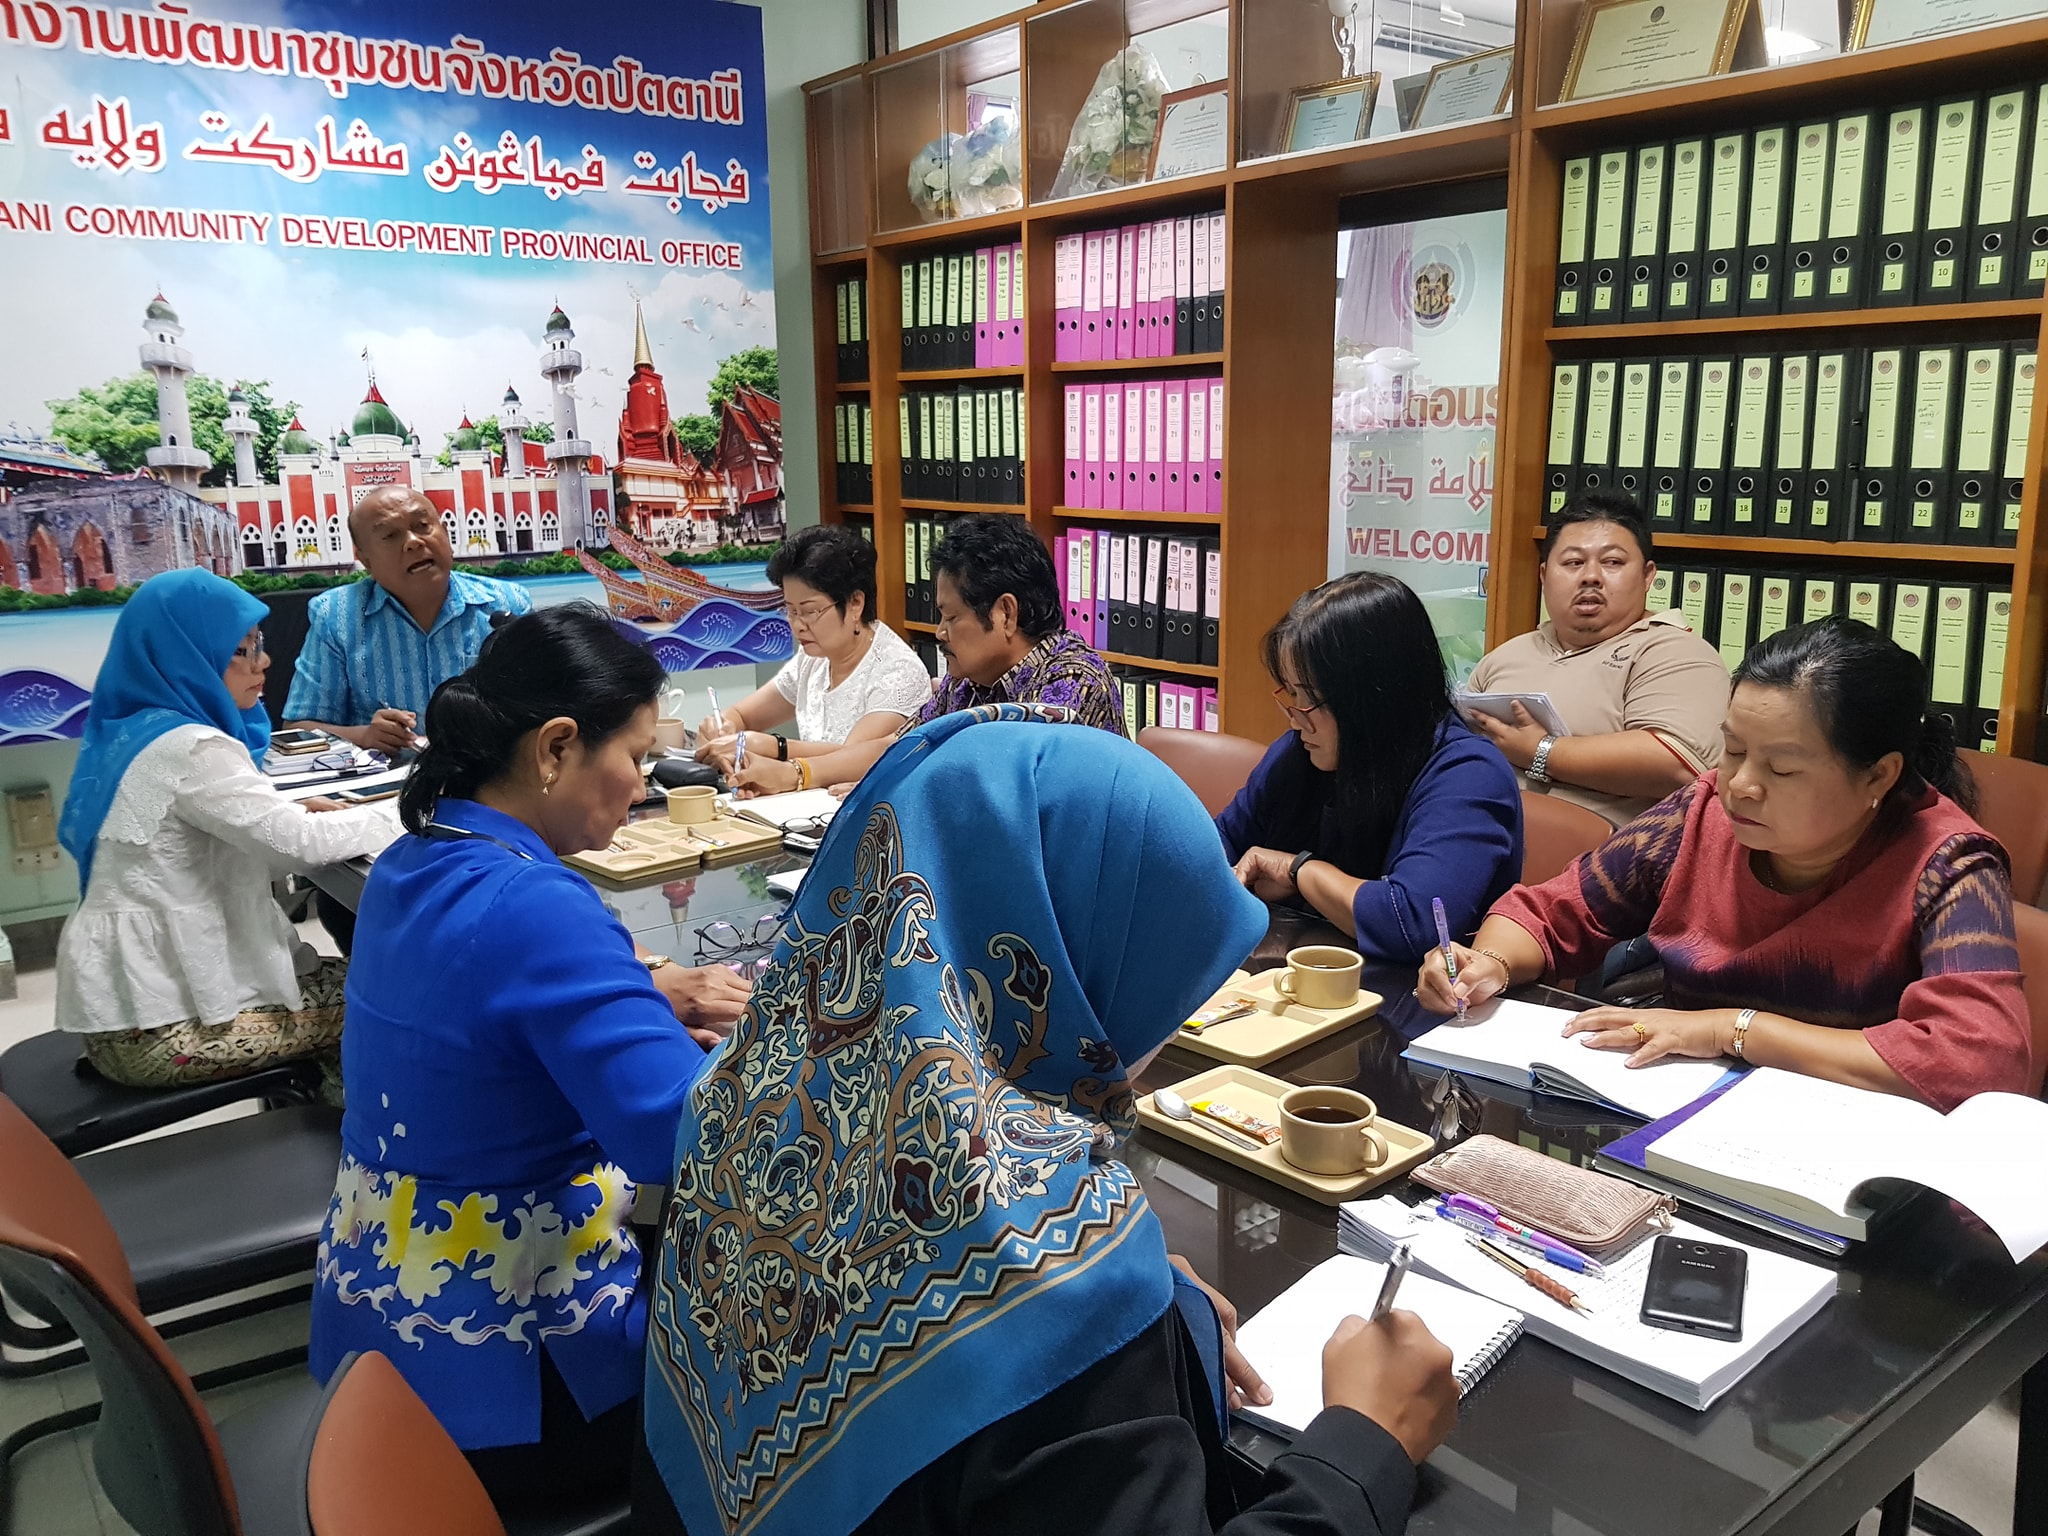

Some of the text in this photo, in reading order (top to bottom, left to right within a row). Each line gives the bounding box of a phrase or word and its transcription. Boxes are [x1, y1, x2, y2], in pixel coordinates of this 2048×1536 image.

[65, 206, 268, 242] COMMUNITY
[282, 217, 492, 252] DEVELOPMENT
[504, 231, 653, 263] PROVINCIAL
[661, 241, 741, 268] OFFICE
[2034, 258, 2047, 268] 12
[1937, 267, 1949, 277] 10
[1984, 263, 1996, 273] 11
[1553, 497, 1562, 505] 13
[1660, 499, 1670, 507] 16
[1698, 503, 1708, 511] 17
[1739, 504, 1749, 512] 18
[1779, 505, 1788, 514] 19
[1815, 507, 1825, 515] 20
[1867, 507, 1877, 517] 21
[1917, 508, 1928, 518] 22
[1964, 509, 1976, 519] 23
[2009, 511, 2021, 520] 24
